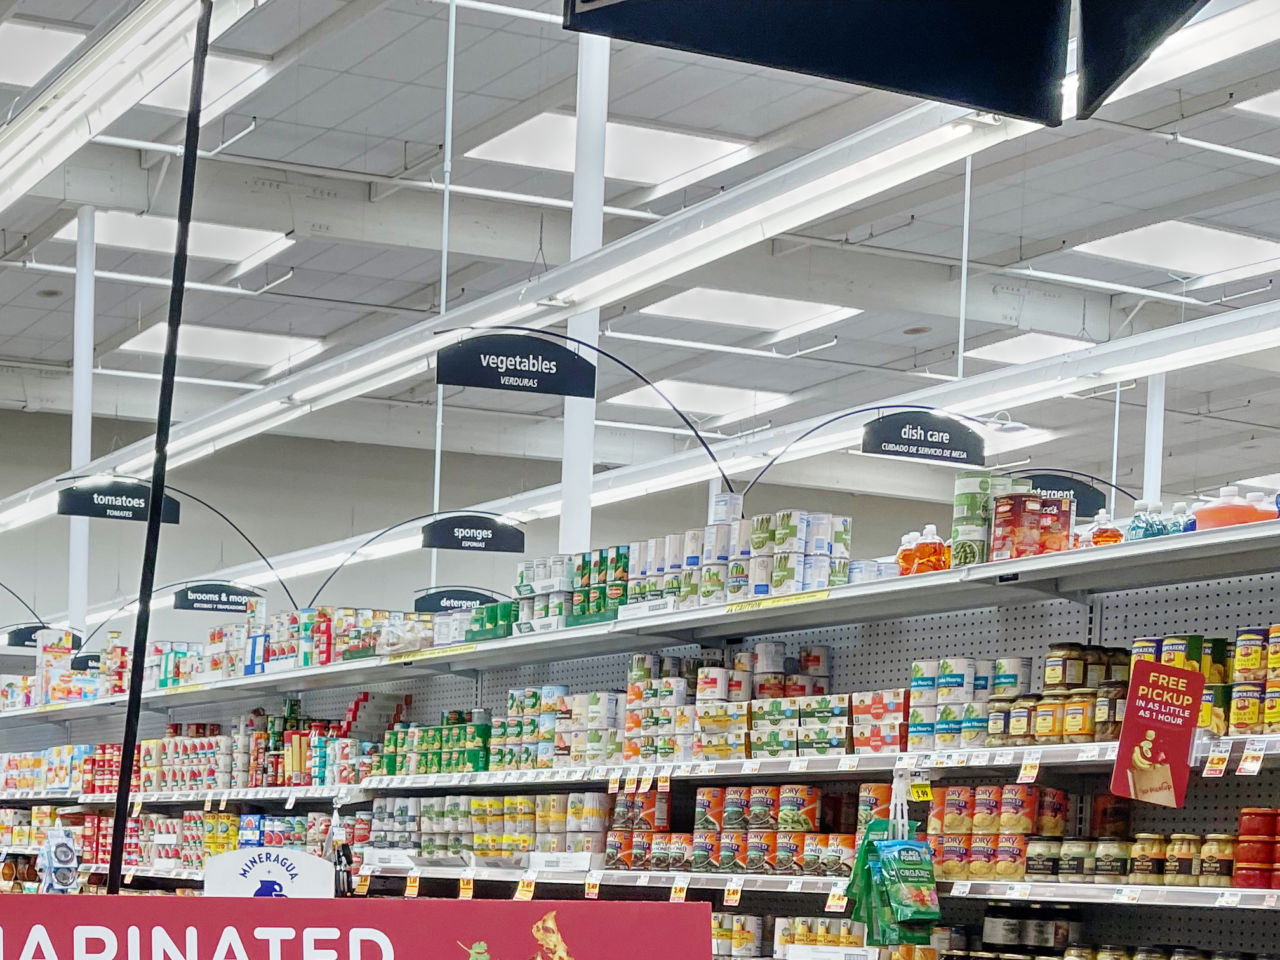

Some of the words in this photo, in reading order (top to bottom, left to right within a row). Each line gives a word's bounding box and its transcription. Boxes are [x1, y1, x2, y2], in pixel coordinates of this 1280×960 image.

[481, 354, 556, 373] vegetables
[500, 376, 537, 387] VERDURAS
[902, 425, 924, 441] dish
[927, 432, 949, 443] care
[882, 443, 907, 452] CUIDADO
[909, 445, 916, 453] DE
[918, 446, 942, 456] SERVICIO
[943, 449, 950, 457] DE
[952, 450, 967, 459] MESA
[93, 493, 144, 507] tomatoes
[107, 509, 132, 517] TOMATES
[454, 527, 492, 539] sponges
[188, 591, 219, 601] brooms
[230, 595, 249, 604] mop
[441, 598, 480, 608] detergent
[1149, 672, 1188, 691] FREE
[1138, 686, 1193, 707] PICKUP
[1136, 699, 1145, 707] IN
[1147, 701, 1160, 711] AS
[1161, 705, 1191, 718] LITTLE
[1138, 709, 1150, 718] AS
[1152, 712, 1156, 720] 1
[1158, 713, 1183, 725] HOUR
[239, 852, 299, 881] MINERAGUA
[899, 870, 930, 878] ORGANIC
